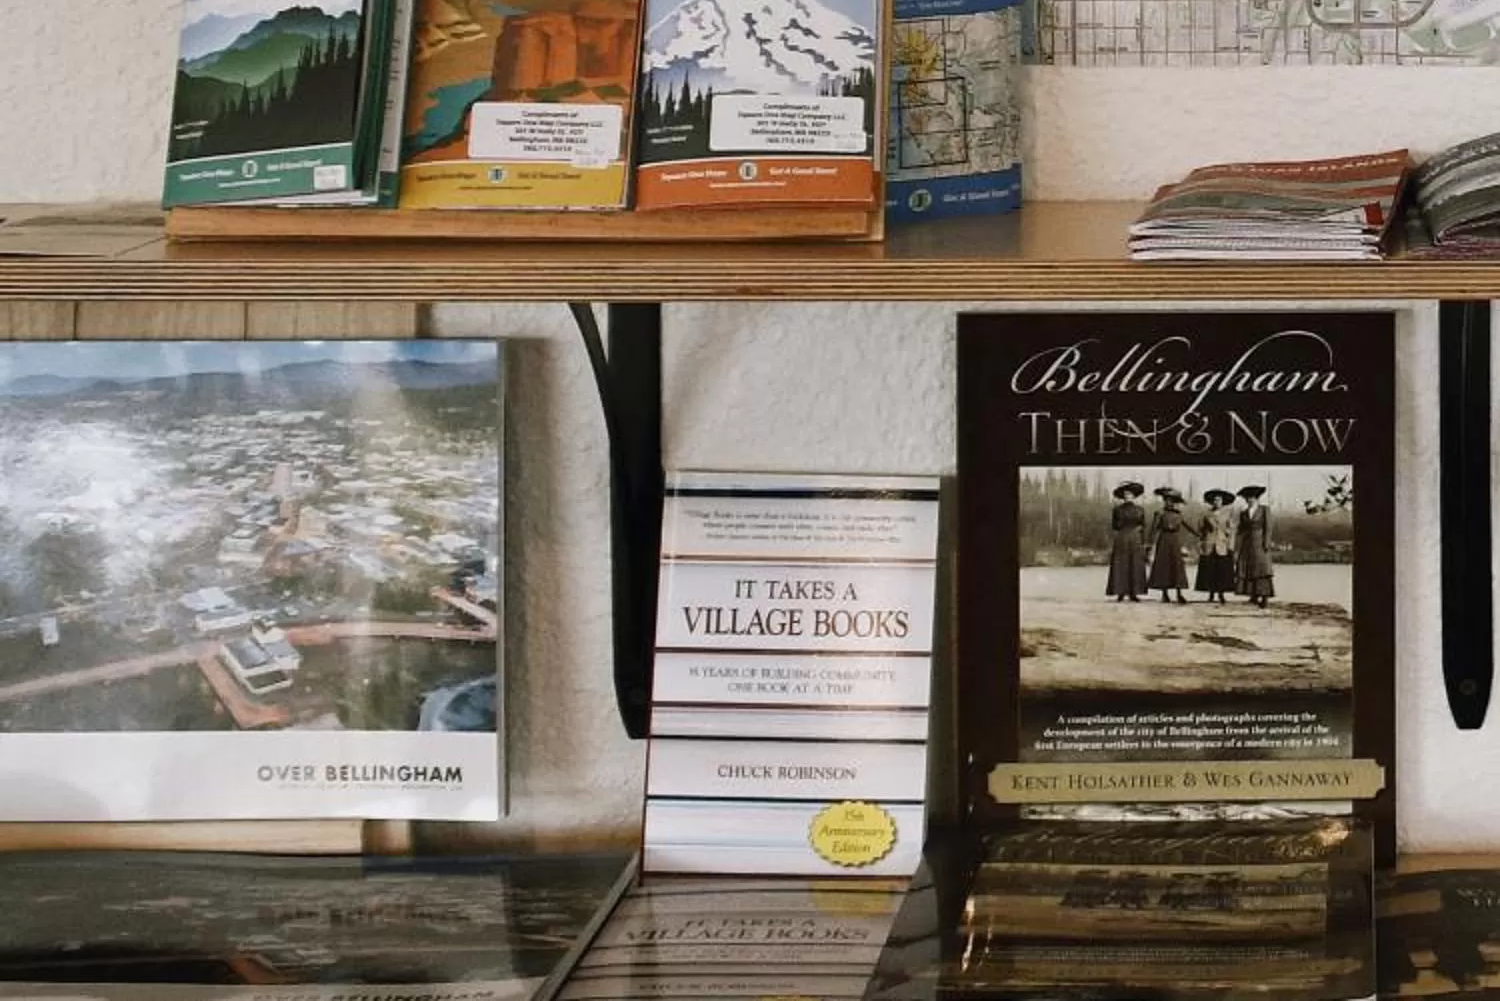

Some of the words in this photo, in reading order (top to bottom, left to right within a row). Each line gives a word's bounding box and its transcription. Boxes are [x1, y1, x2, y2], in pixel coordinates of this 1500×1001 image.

[1010, 330, 1348, 422] Bellingham
[1017, 411, 1158, 454] THEN
[1176, 412, 1213, 454] &
[1228, 410, 1358, 454] NOW
[735, 579, 757, 600] IT
[765, 580, 836, 601] TAKES
[843, 582, 858, 601] A
[682, 606, 803, 638] VILLAGE
[814, 610, 910, 638] BOOKS
[257, 764, 316, 783] OVER
[325, 764, 463, 783] BELLINGHAM
[717, 765, 773, 780] CHUCK
[778, 766, 857, 781] ROBINSON
[1011, 773, 1059, 791] KENT
[1068, 773, 1174, 790] HOLSATHER
[1182, 772, 1199, 787] &
[1204, 770, 1241, 788] WES
[1249, 771, 1353, 788] GANNAWAY
